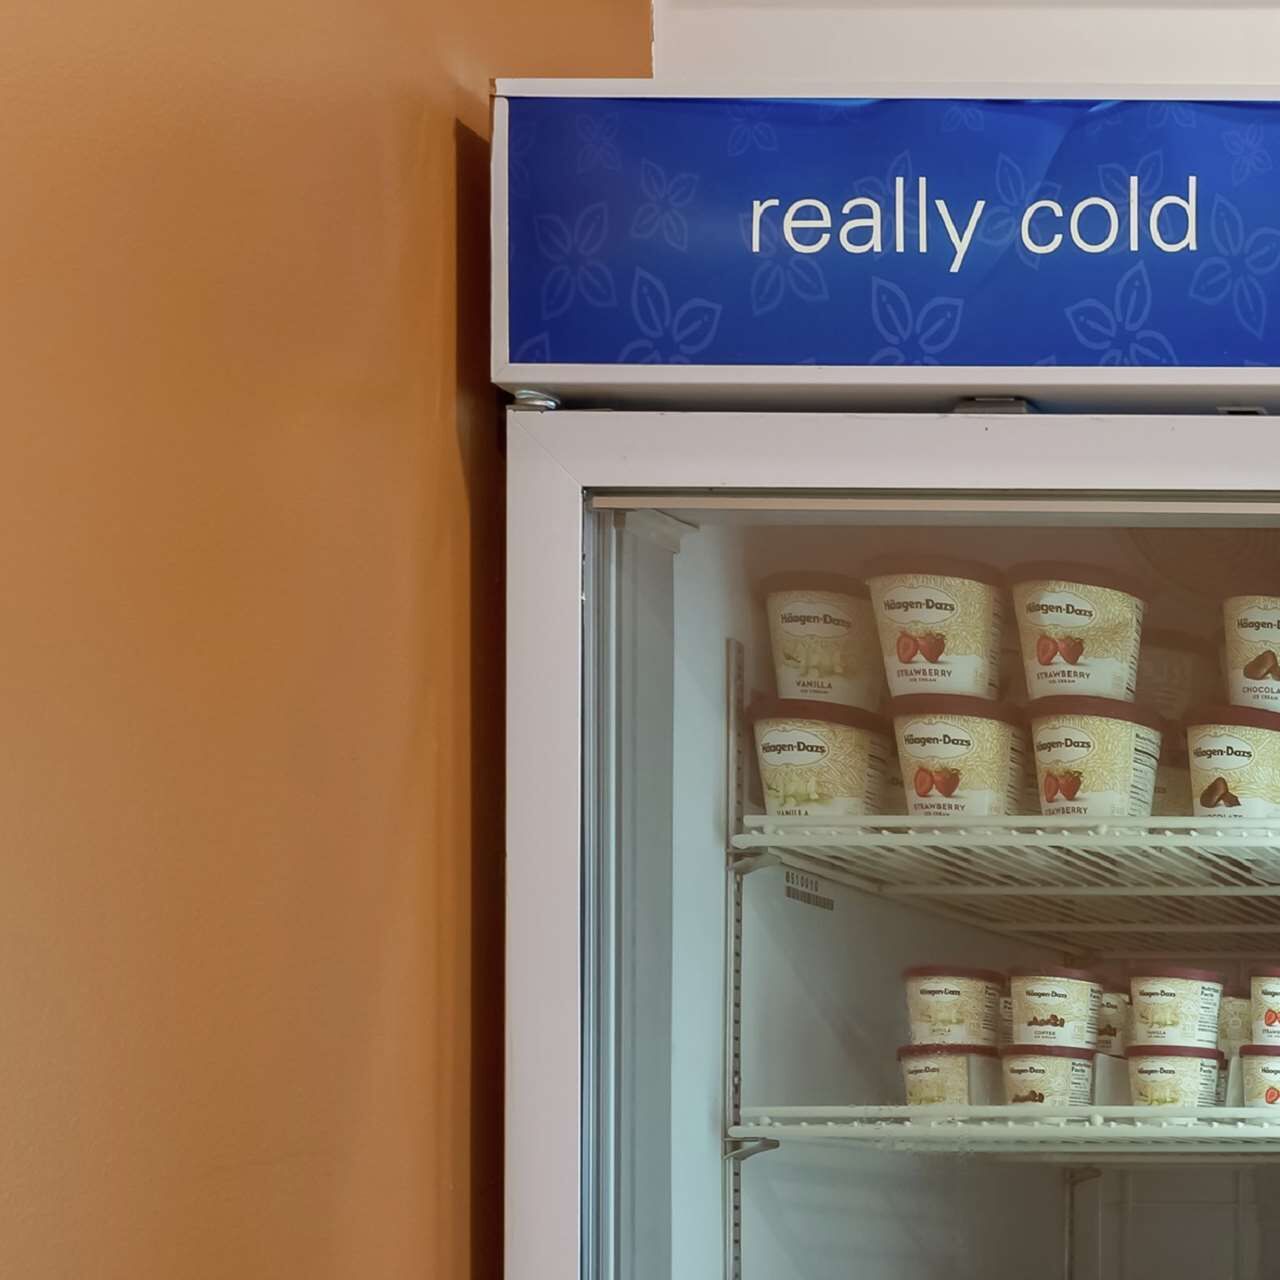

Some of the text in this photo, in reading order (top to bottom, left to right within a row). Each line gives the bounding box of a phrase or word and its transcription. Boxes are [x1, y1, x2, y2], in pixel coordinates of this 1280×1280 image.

[751, 175, 1200, 273] really cold
[884, 598, 955, 613] Häagen-Dazs
[897, 668, 953, 679] STRAWBERRY
[795, 679, 833, 690] VANILLA
[1036, 738, 1091, 752] agen-Dazs
[1044, 807, 1088, 815] TRAWBERRY
